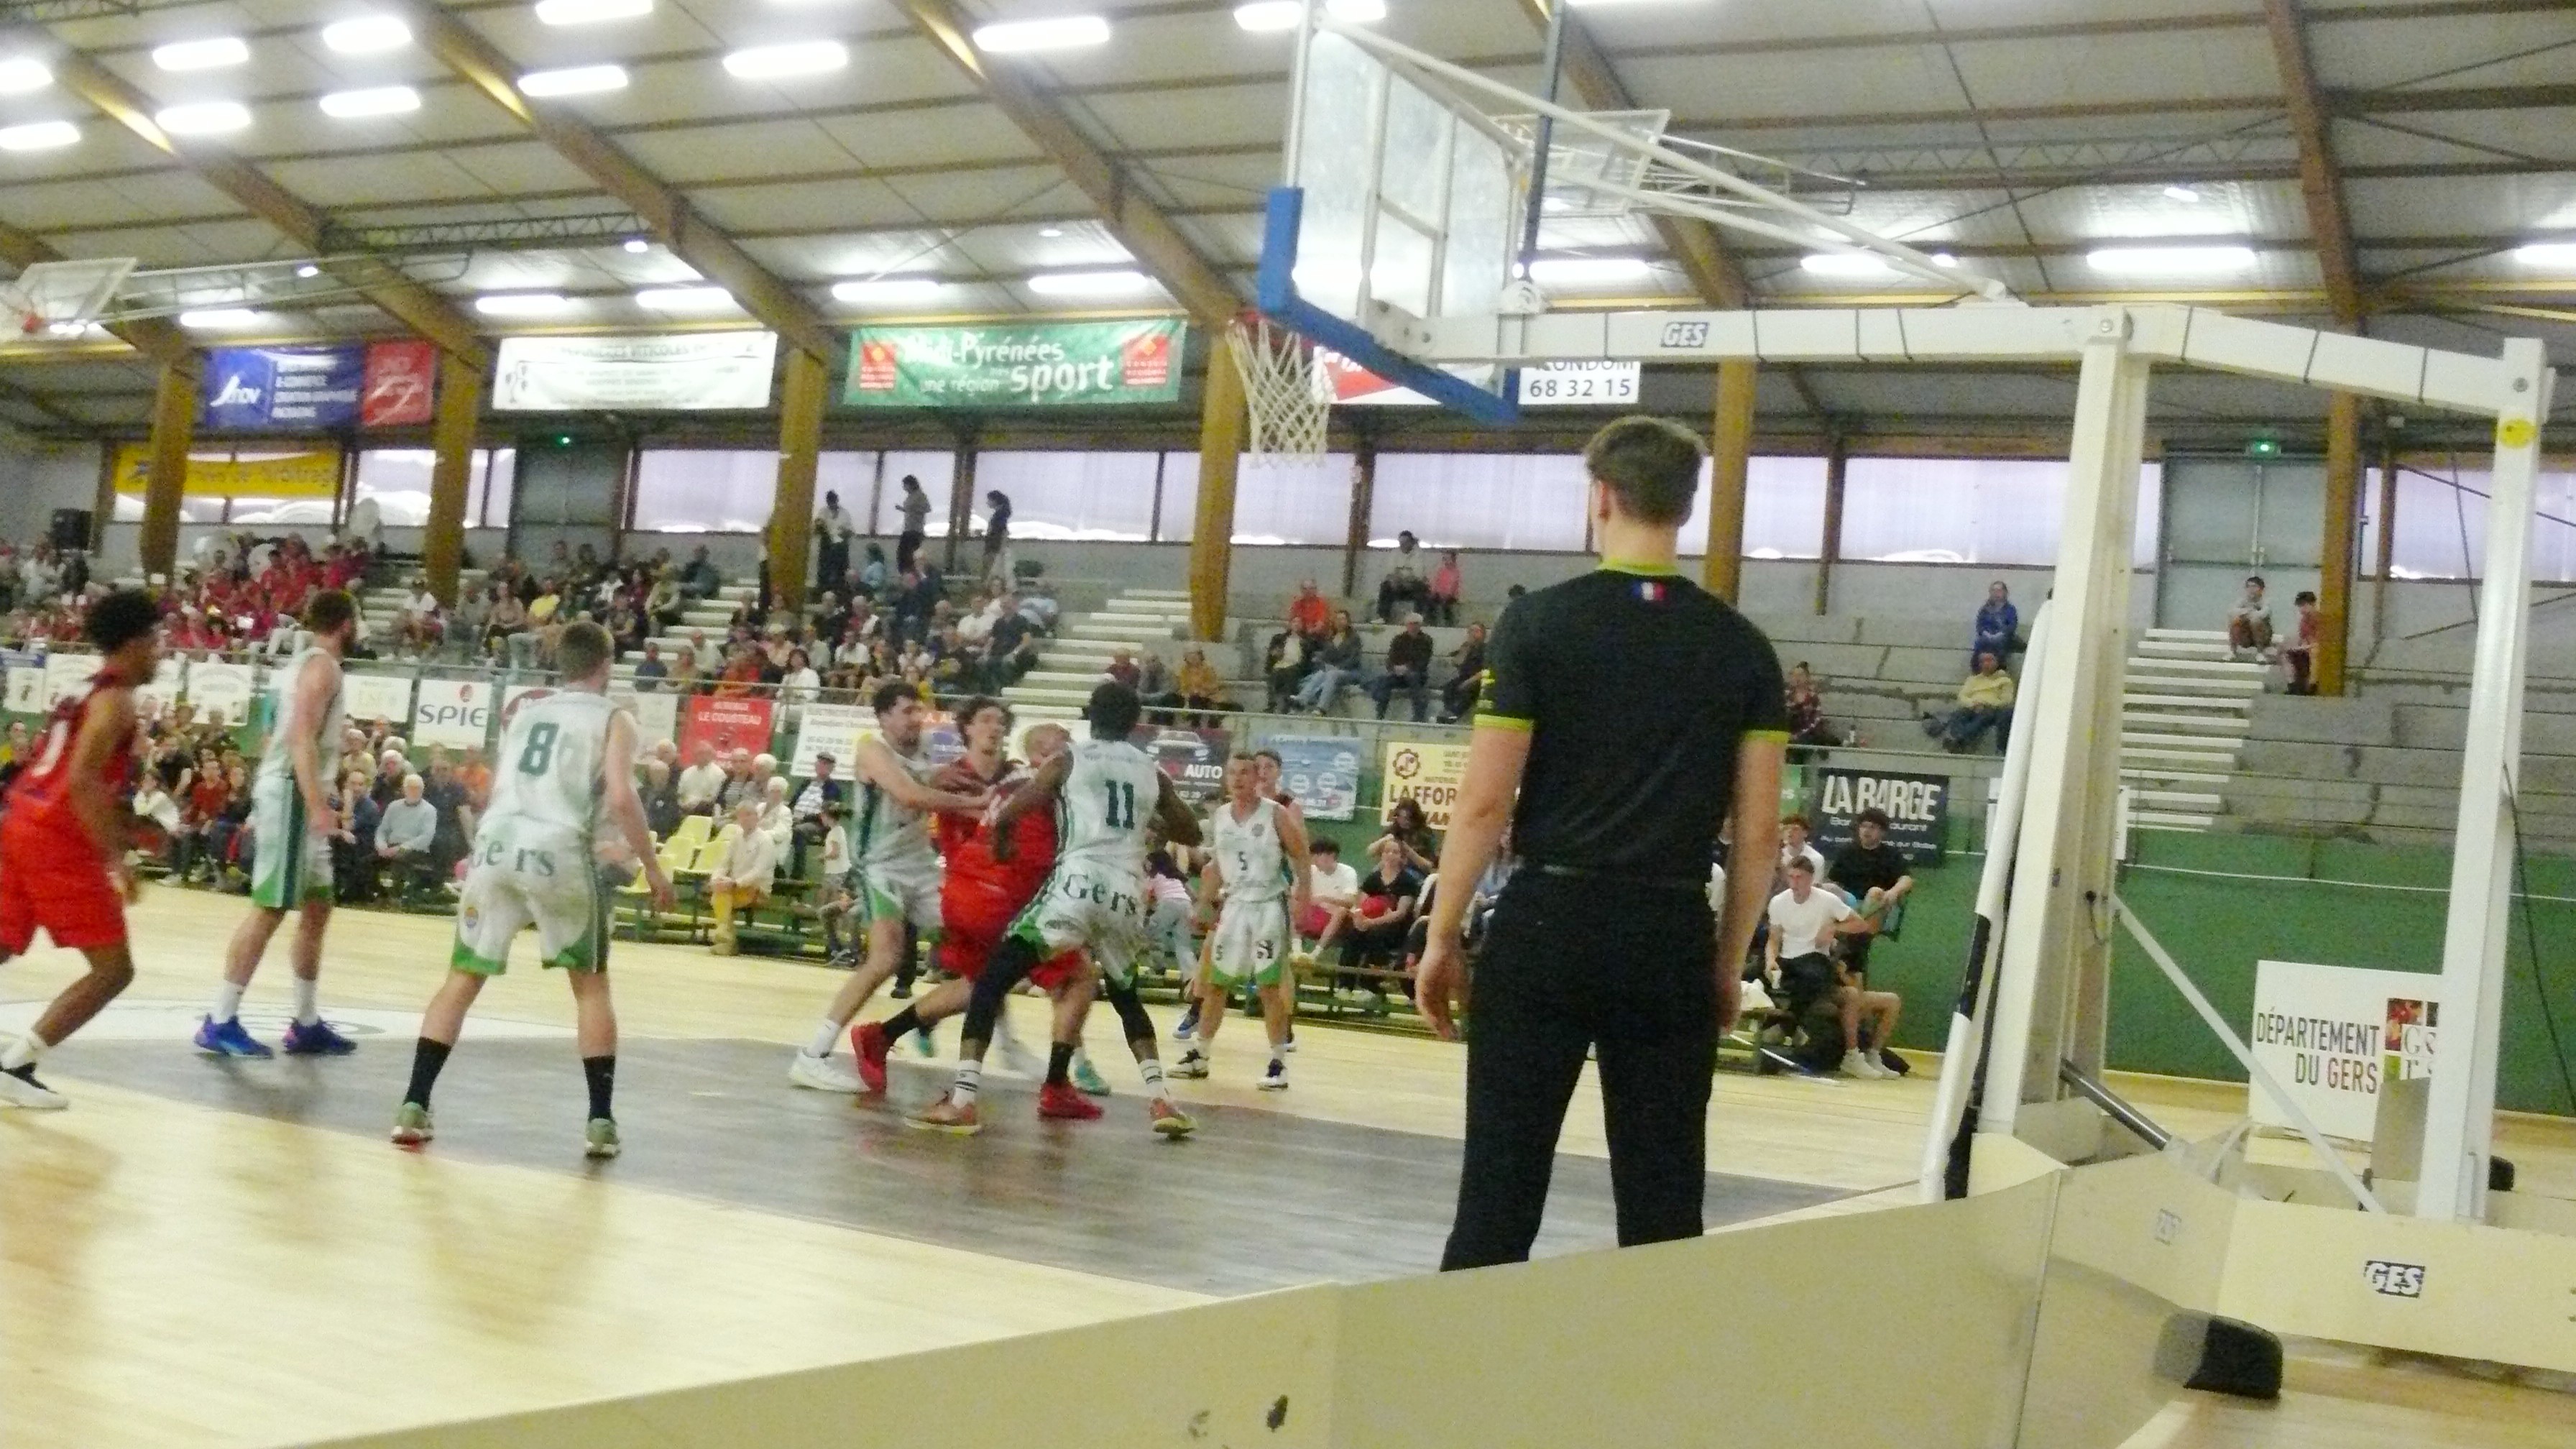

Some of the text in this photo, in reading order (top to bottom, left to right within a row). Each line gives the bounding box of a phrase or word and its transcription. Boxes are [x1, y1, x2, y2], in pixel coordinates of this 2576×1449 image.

[1662, 323, 1707, 347] GES
[1010, 354, 1114, 402] sport
[1530, 378, 1631, 397] 68 32 15
[418, 704, 487, 727] SPIE
[518, 722, 559, 776] 8
[1184, 763, 1223, 779] AUTO
[1105, 779, 1136, 830] 11
[1821, 775, 1941, 822] LA BARGE
[1063, 873, 1137, 916] Gers
[2255, 1006, 2380, 1057] DÉPARTEMENT
[2294, 1052, 2378, 1095] DU GERS
[2366, 1262, 2424, 1296] GES
